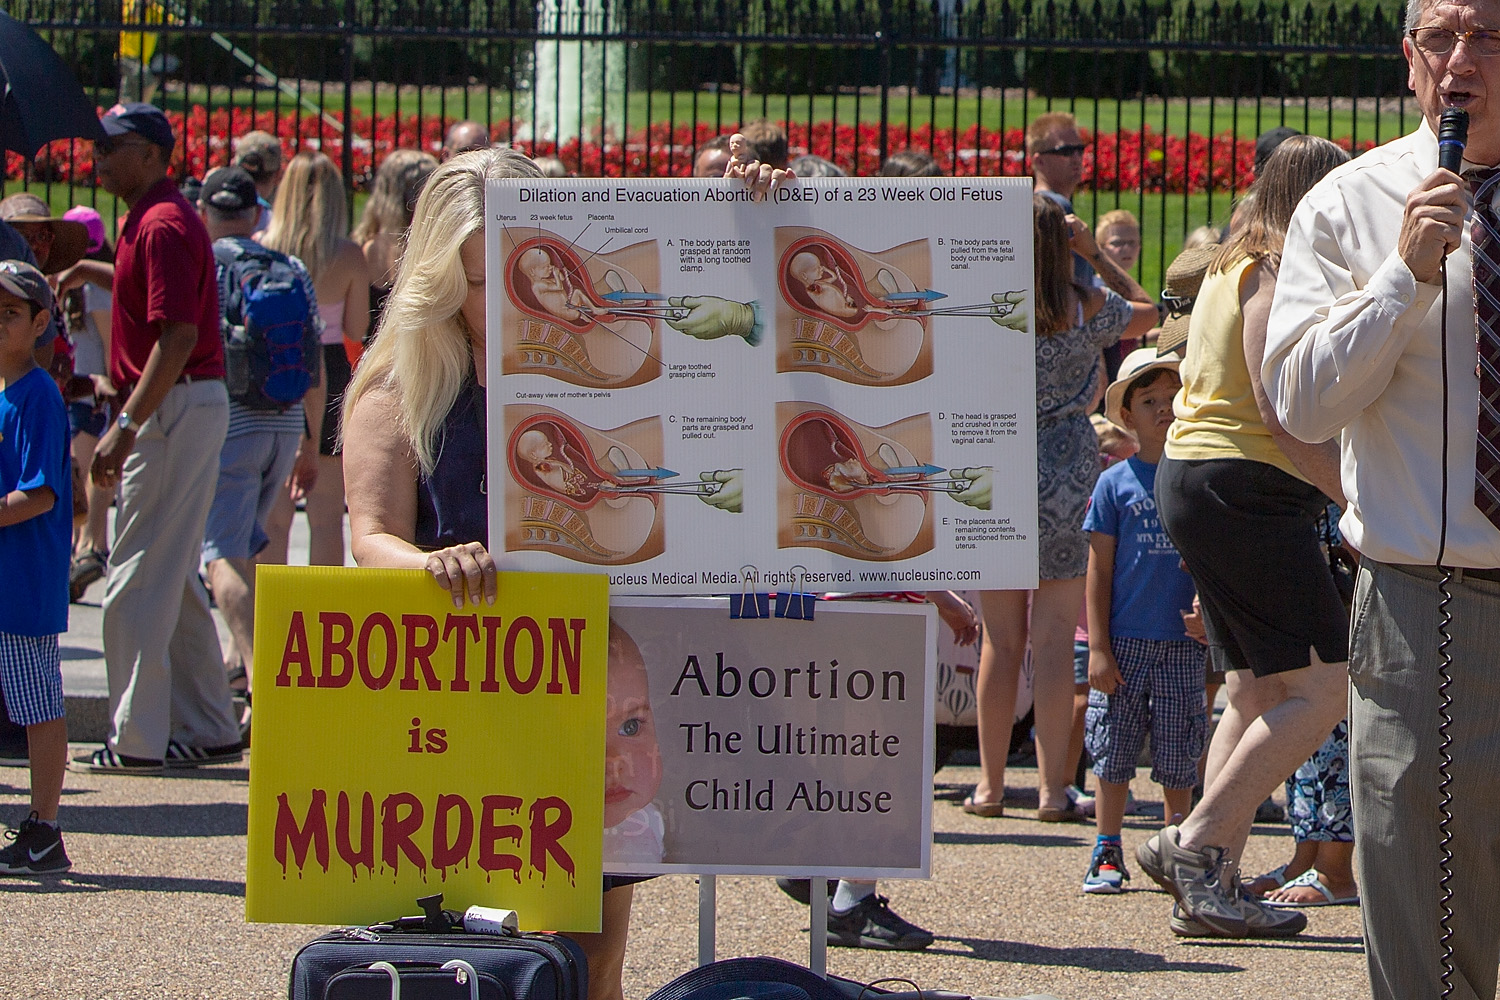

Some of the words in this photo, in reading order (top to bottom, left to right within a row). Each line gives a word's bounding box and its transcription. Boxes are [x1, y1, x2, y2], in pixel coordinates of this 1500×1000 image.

[519, 188, 577, 203] Dilation
[582, 188, 610, 203] and
[616, 188, 700, 203] Evacuation
[773, 187, 819, 205] (D&E)
[824, 187, 839, 202] of
[843, 190, 853, 202] a
[857, 188, 877, 202] 23
[881, 187, 926, 202] Week
[929, 187, 958, 202] Old
[961, 187, 1004, 202] Fetus
[679, 239, 694, 247] The
[696, 239, 715, 248] body
[716, 239, 736, 248] parts
[680, 248, 711, 256] grasped
[722, 247, 751, 255] random
[680, 256, 696, 264] with
[704, 256, 720, 264] long
[951, 255, 967, 263] body
[991, 255, 1015, 263] vaginal
[680, 264, 705, 273] clamp.
[669, 370, 695, 379] grasping
[669, 415, 677, 423] C.
[938, 412, 947, 420] D.
[990, 413, 1016, 421] grasped
[712, 424, 739, 432] grasped
[682, 432, 702, 440] pulled
[951, 437, 975, 445] vaginal
[1129, 497, 1155, 516] PO
[942, 517, 950, 525] E.
[969, 518, 996, 526] placenta
[955, 526, 987, 534] remaining
[606, 572, 648, 586] ucleus
[652, 571, 698, 585] Medical
[702, 571, 741, 586] Media.
[746, 571, 760, 584] All
[764, 570, 796, 587] rights
[801, 570, 855, 584] reserved.
[858, 569, 981, 583] www.nucleusinc.com
[276, 610, 586, 695] ABORTION
[670, 651, 906, 702] Abortion
[407, 717, 448, 755] is
[679, 723, 742, 755] The
[757, 724, 900, 757] Ultimate
[685, 779, 774, 812] Child
[786, 780, 892, 814] Abuse
[274, 788, 575, 887] MURDER
